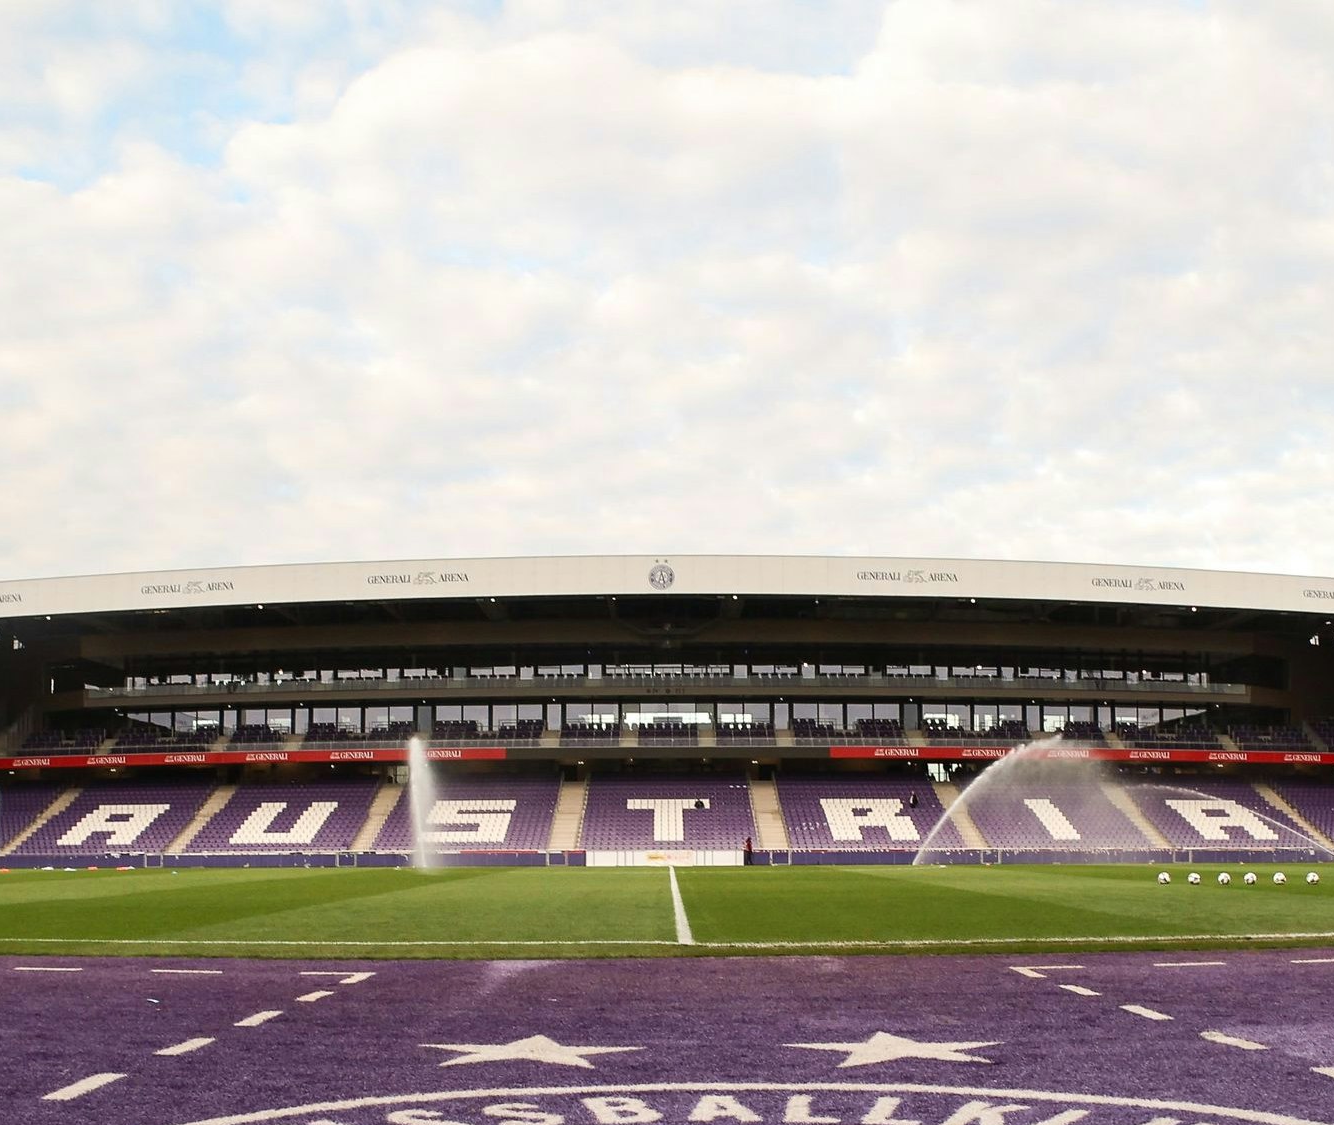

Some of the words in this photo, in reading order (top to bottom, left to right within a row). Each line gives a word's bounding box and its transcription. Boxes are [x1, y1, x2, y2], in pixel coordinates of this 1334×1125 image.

[367, 574, 411, 585] GENERALI
[438, 573, 469, 583] ARENA
[856, 571, 901, 581] GENERALI
[928, 572, 958, 582] ARENA
[140, 583, 181, 595] GENERALI
[206, 581, 234, 591] ARENA
[1091, 577, 1133, 588] GENERALI
[1158, 581, 1185, 591] ARENA
[254, 752, 288, 762] GENERALI
[340, 751, 374, 760] GENERALI
[427, 750, 462, 759] GENERALI
[885, 748, 920, 758] GENERALI
[972, 749, 1006, 758] GENERALI
[1056, 750, 1089, 759] GENERALI
[1138, 750, 1170, 759] GENERALI
[1217, 752, 1248, 761] GENERALI
[1293, 753, 1321, 762] GENERALI
[21, 758, 50, 767] GENERALI
[95, 756, 127, 765] GENERALI
[175, 754, 206, 763] GENERALI
